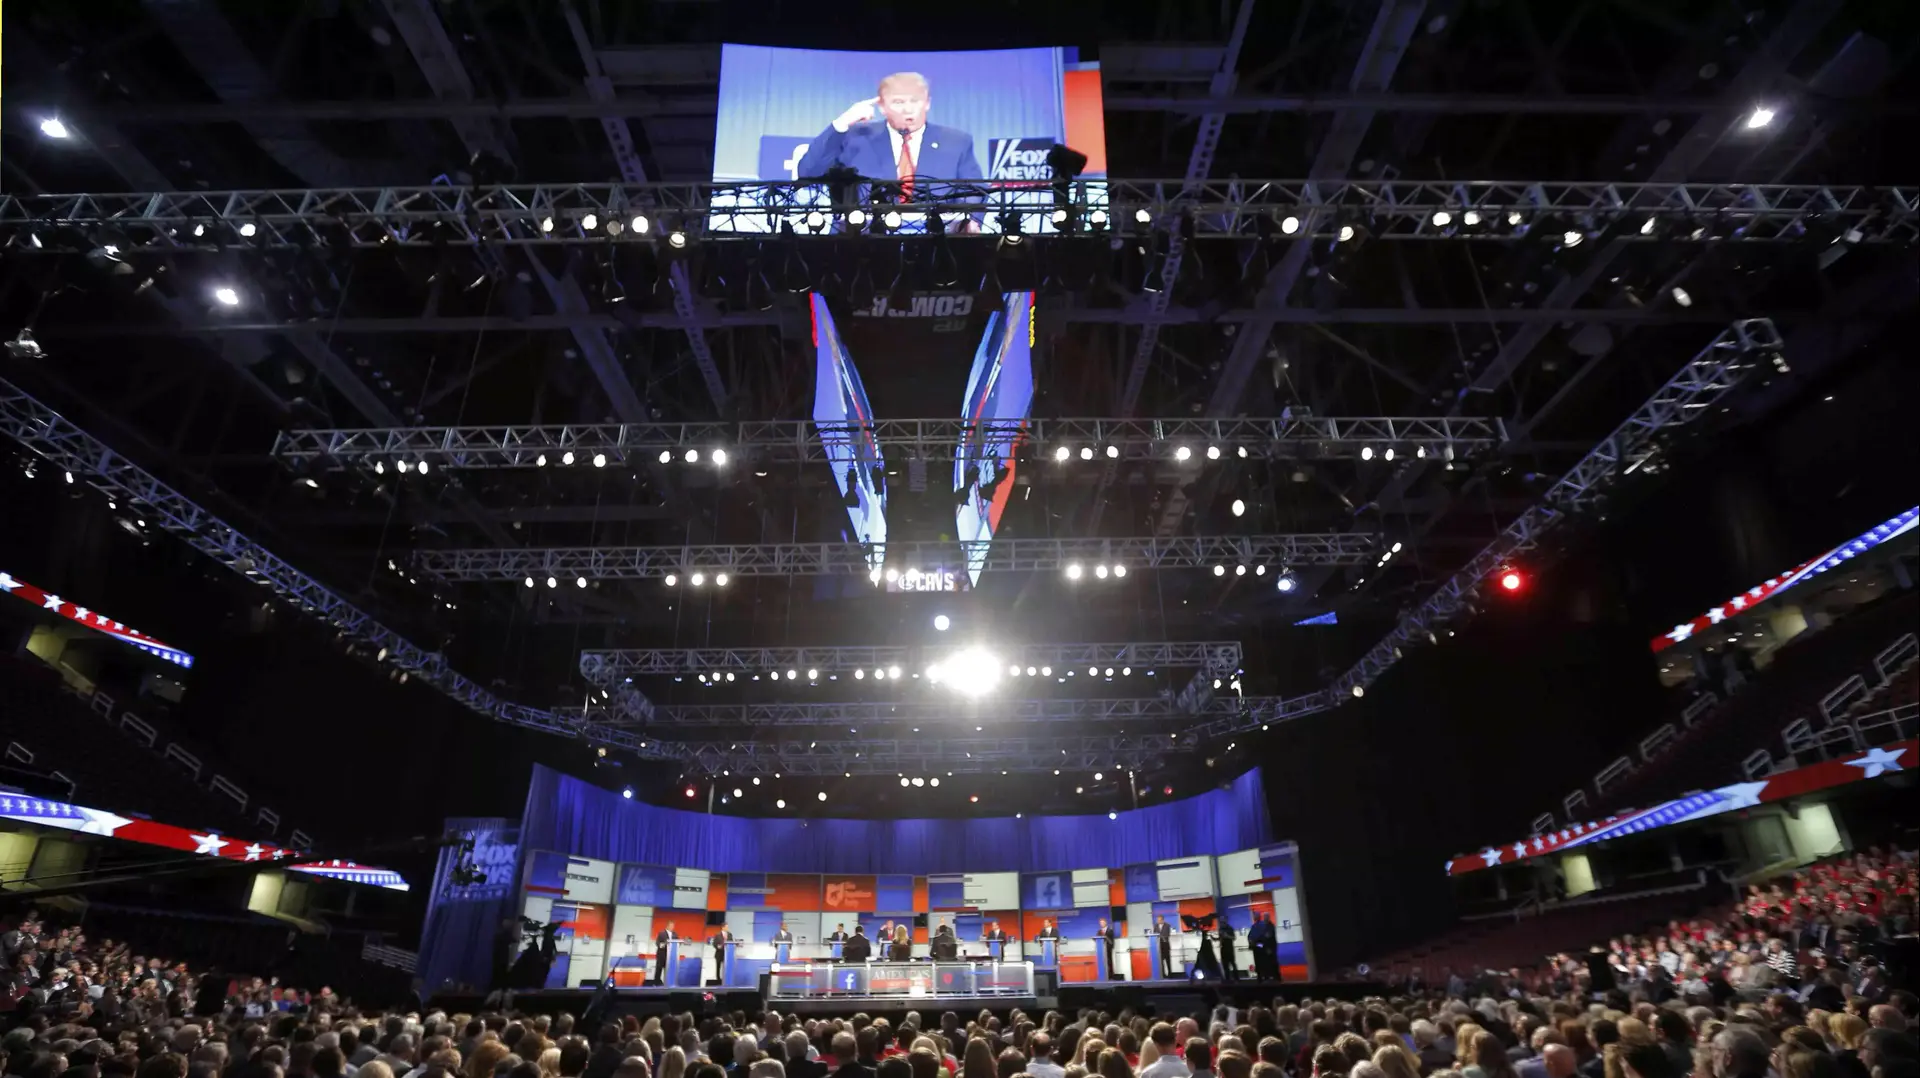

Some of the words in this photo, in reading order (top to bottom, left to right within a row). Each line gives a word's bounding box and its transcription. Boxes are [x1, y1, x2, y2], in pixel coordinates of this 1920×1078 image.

[1010, 149, 1050, 166] FOX
[998, 165, 1053, 180] NEWS
[916, 572, 954, 592] CAVS
[845, 973, 855, 989] f
